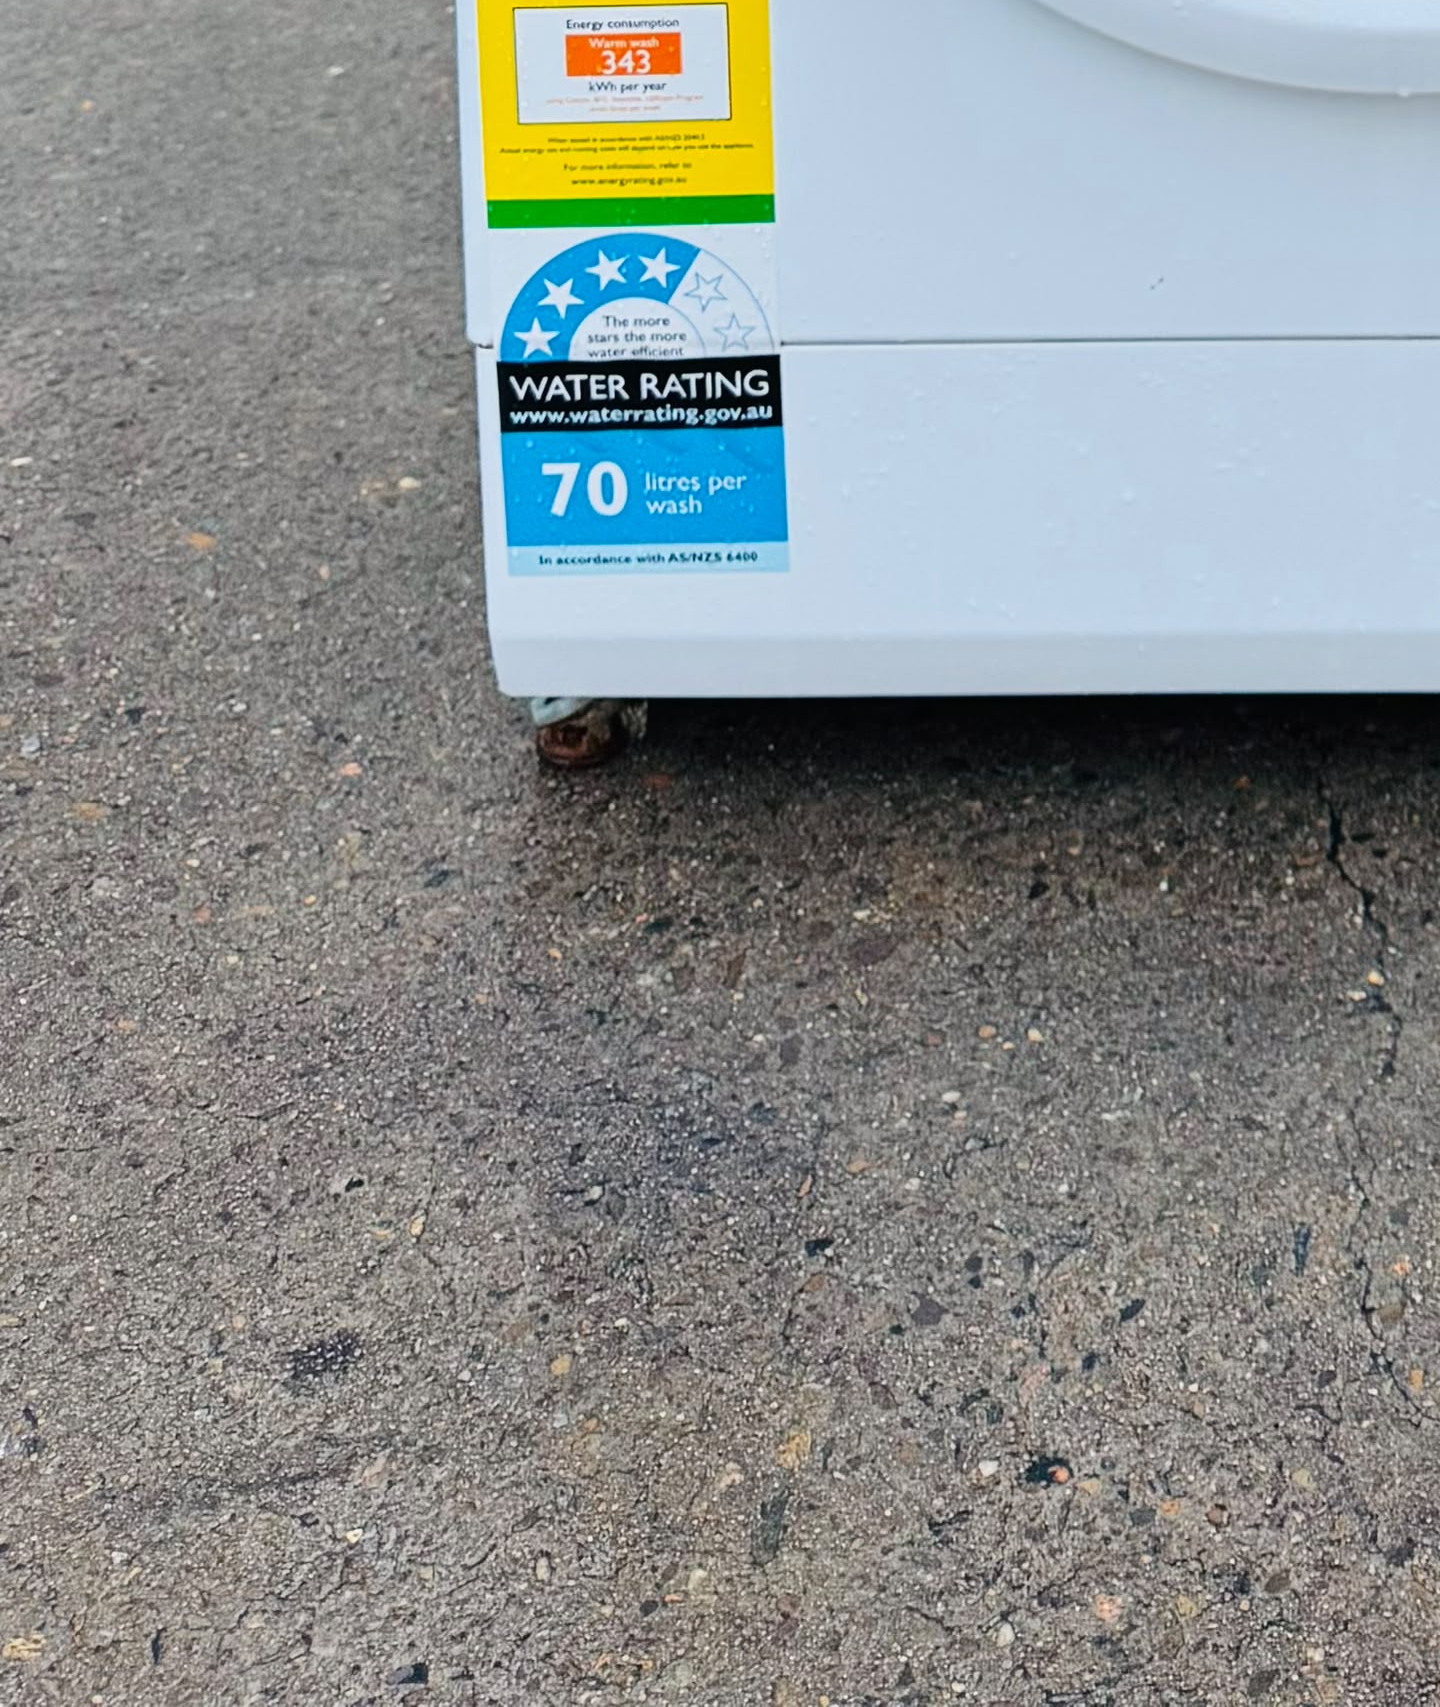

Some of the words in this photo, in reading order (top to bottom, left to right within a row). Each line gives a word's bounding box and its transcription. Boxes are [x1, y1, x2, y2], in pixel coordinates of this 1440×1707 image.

[566, 19, 604, 31] Energy
[607, 17, 680, 30] consumption
[588, 37, 628, 49] Warm
[630, 37, 660, 48] wash
[601, 50, 651, 74] 343
[588, 81, 617, 92] kWh
[620, 82, 639, 94] per
[643, 81, 667, 94] year
[602, 315, 630, 327] The
[633, 317, 670, 327] more
[587, 333, 620, 344] stars
[624, 331, 646, 342] the
[650, 332, 687, 342] more
[587, 347, 627, 358] water
[631, 346, 684, 357] efficient
[508, 374, 628, 402] WATER
[640, 369, 770, 400] RATING
[510, 403, 773, 426] www.waterrating.gov.au
[541, 460, 628, 517] 70
[645, 471, 702, 492] litres
[708, 473, 747, 496] per
[645, 495, 703, 515] wash
[539, 555, 552, 565] In
[556, 553, 632, 565] accordance
[636, 553, 665, 564] with
[667, 551, 722, 563] AS/NZS
[726, 550, 758, 563] 6400
